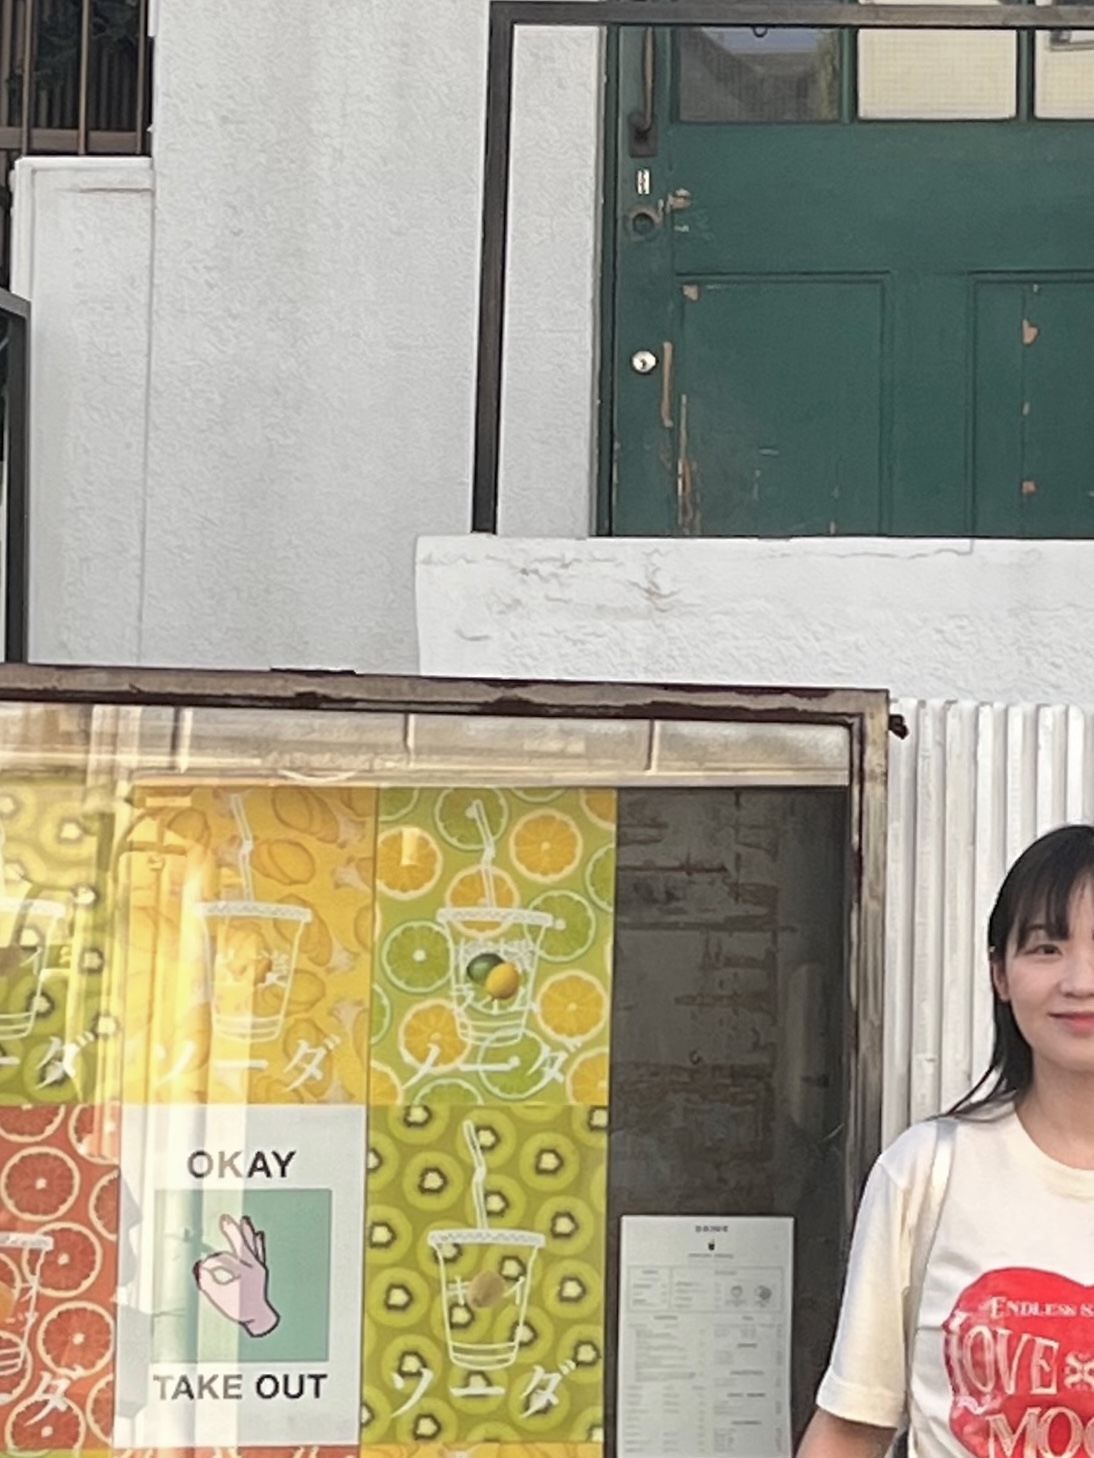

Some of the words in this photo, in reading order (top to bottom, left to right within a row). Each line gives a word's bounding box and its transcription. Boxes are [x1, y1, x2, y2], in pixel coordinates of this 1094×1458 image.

[187, 1150, 296, 1178] OKAY
[154, 1374, 243, 1400] TAKE
[255, 1374, 328, 1400] OUT
